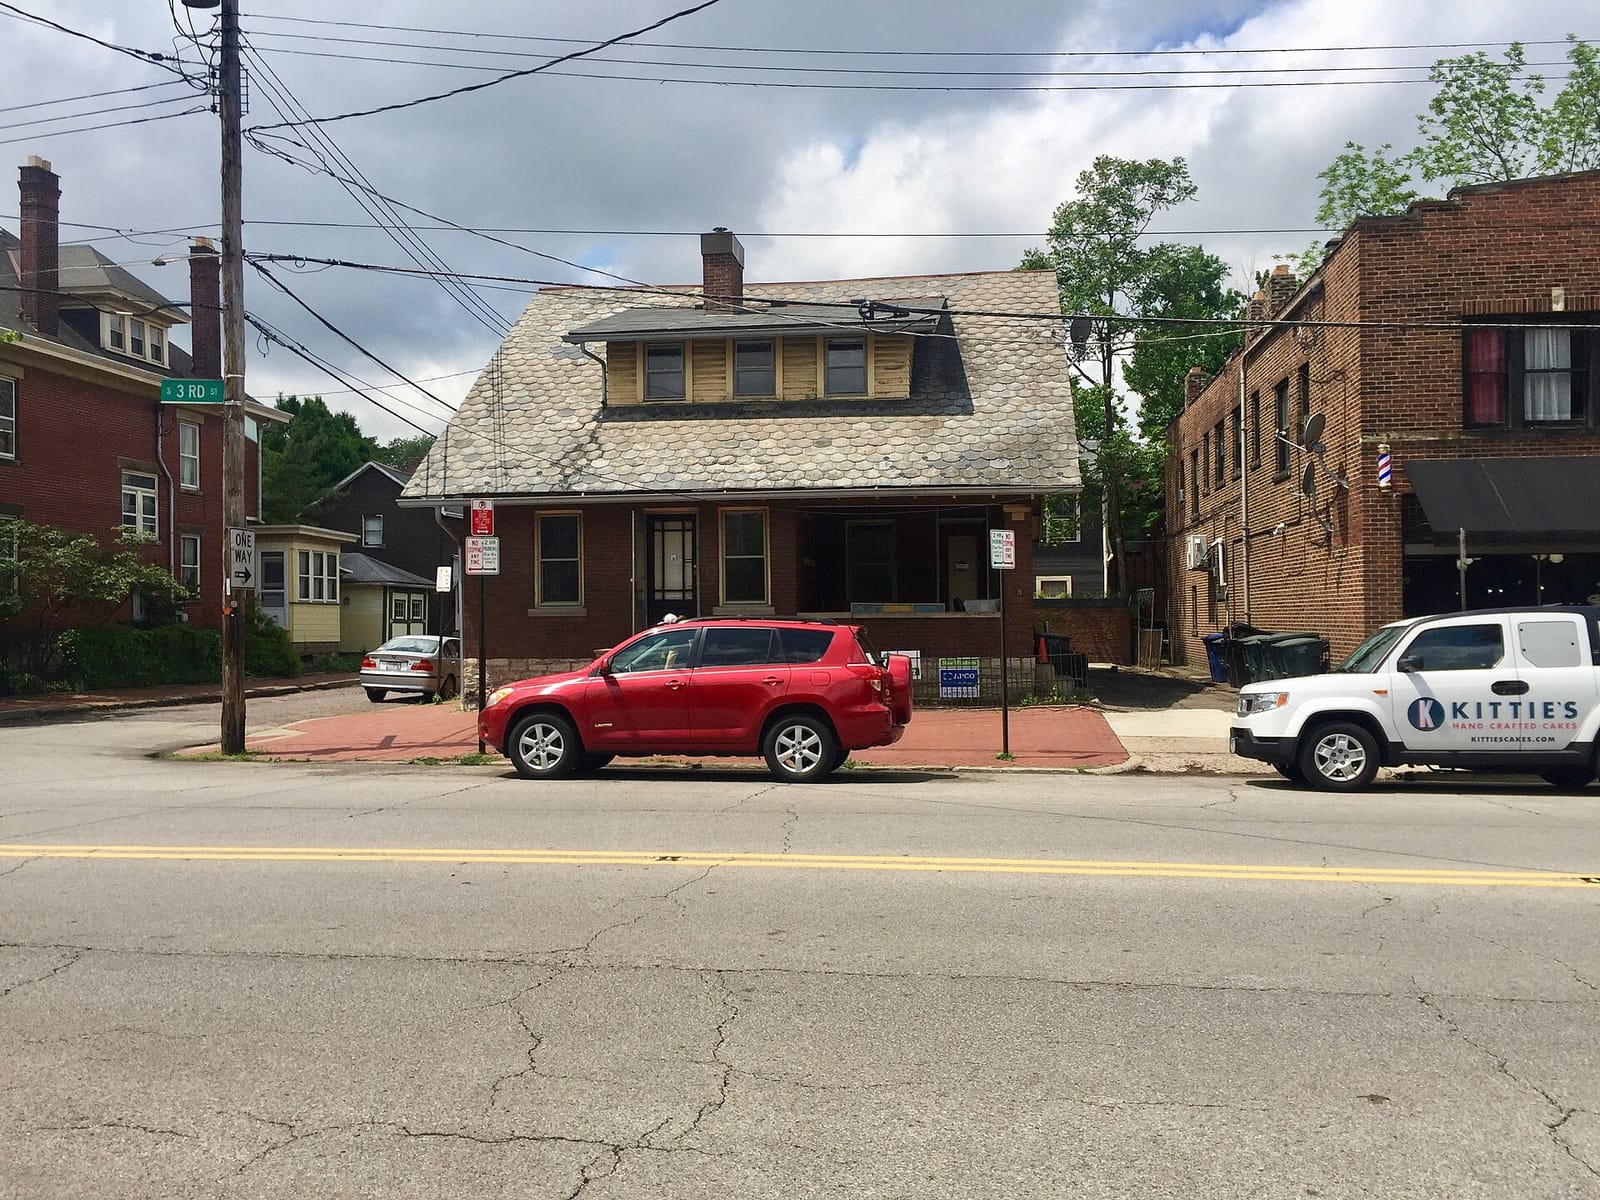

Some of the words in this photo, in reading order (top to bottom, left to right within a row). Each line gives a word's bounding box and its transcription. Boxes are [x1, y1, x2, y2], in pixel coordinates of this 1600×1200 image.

[176, 384, 184, 398] 3
[188, 384, 205, 398] RD
[210, 388, 218, 396] ST
[236, 532, 252, 548] ONE
[235, 550, 252, 564] WAY
[1452, 701, 1578, 720] KITTIE'S
